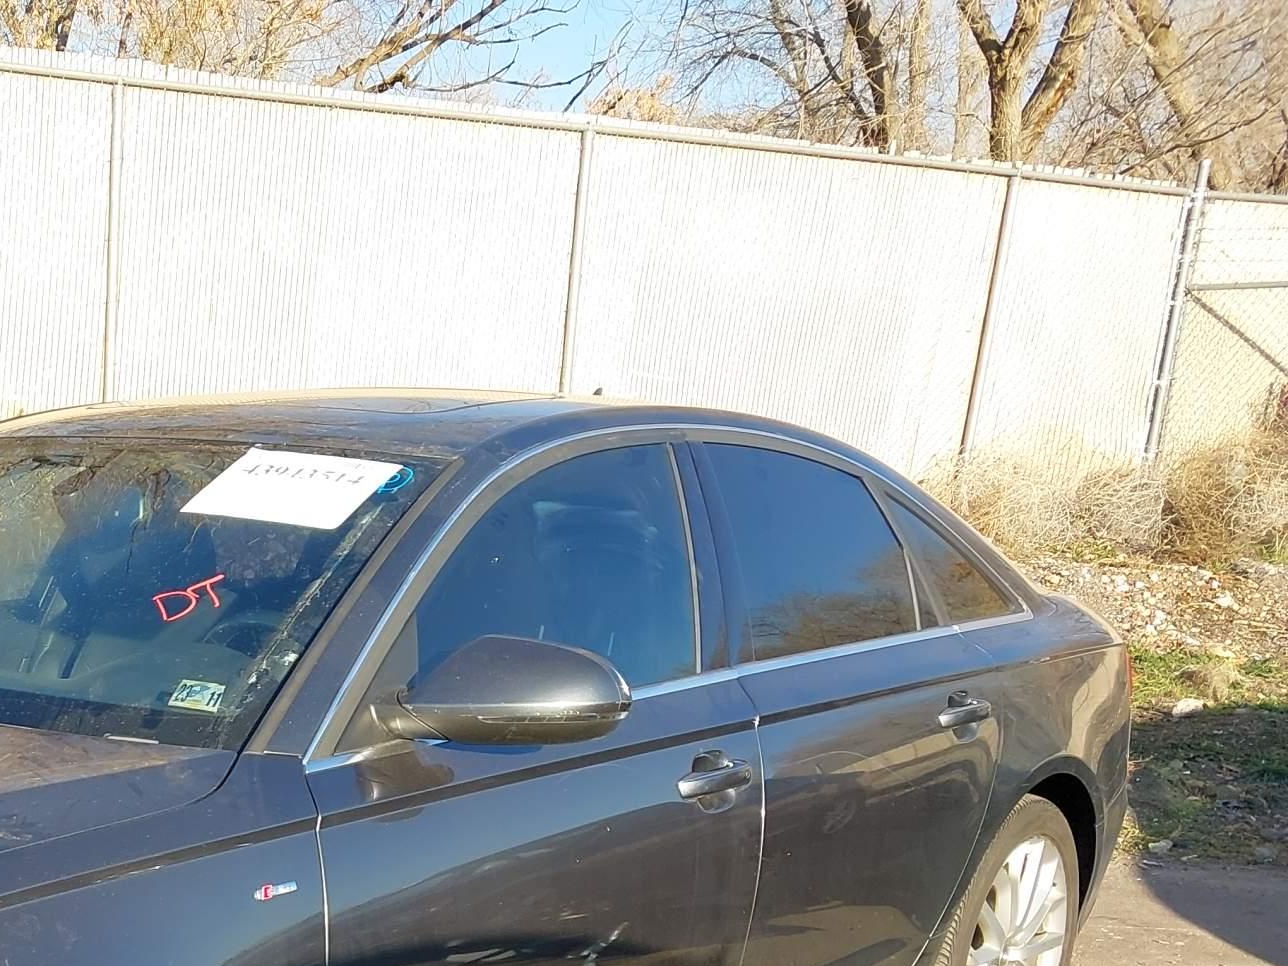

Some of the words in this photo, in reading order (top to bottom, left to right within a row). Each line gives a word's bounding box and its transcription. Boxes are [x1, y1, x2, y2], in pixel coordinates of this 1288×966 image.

[152, 574, 224, 622] DT
[173, 684, 193, 702] 23
[206, 691, 222, 707] 11
